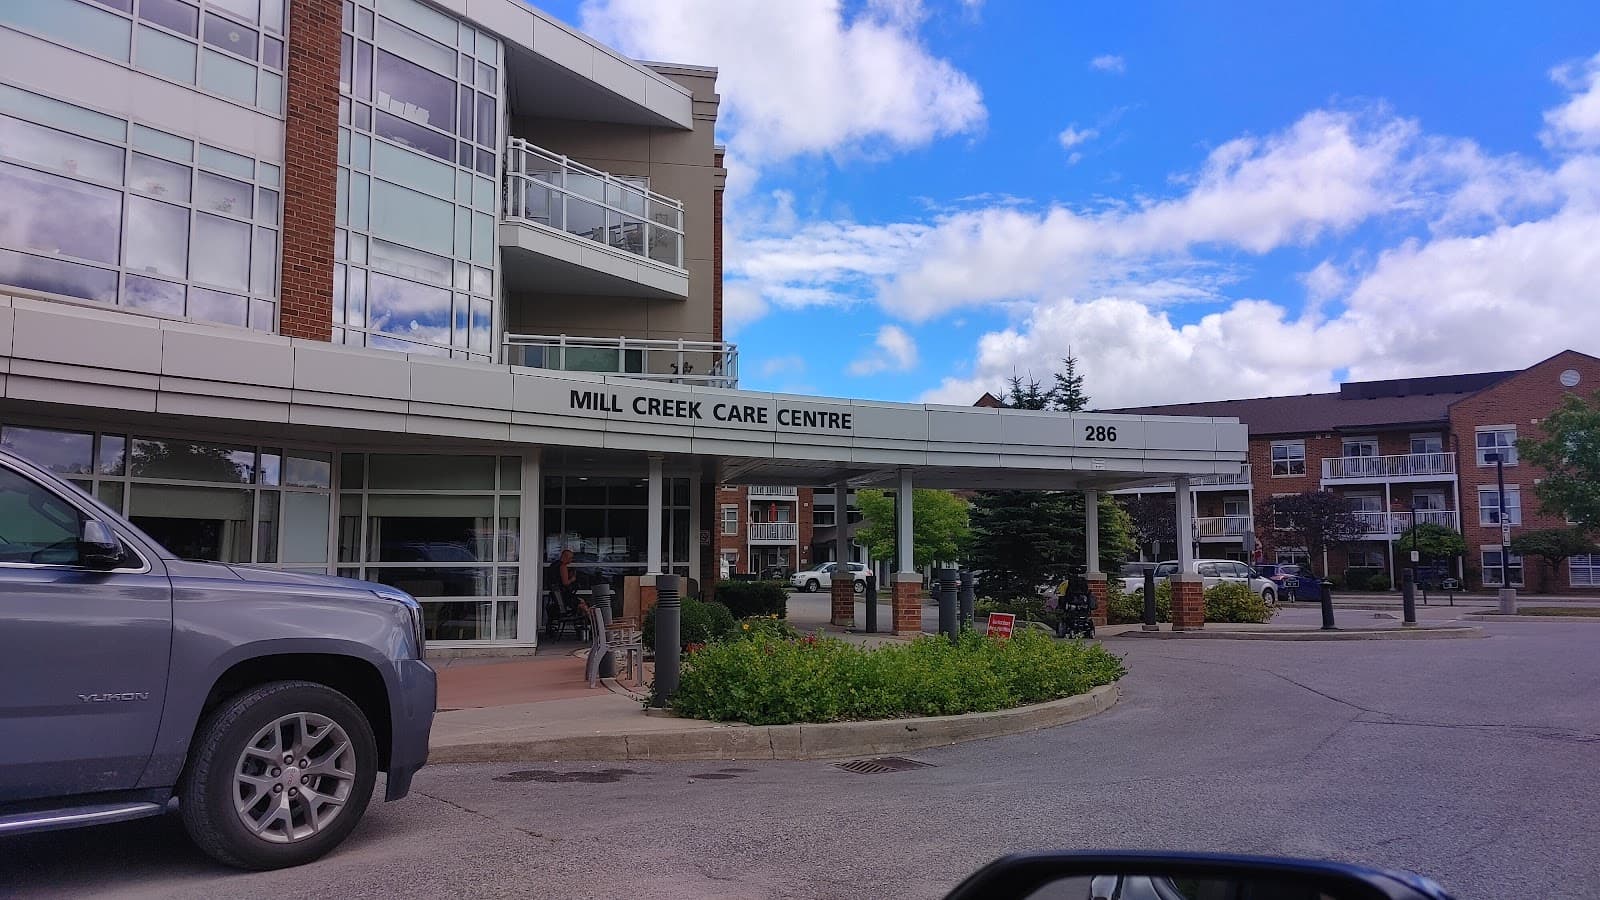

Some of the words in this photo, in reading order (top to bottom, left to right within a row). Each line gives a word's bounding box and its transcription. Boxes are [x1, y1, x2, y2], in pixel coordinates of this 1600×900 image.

[570, 390, 623, 413] MILL
[632, 396, 703, 419] CREEK
[713, 403, 768, 424] CARE
[777, 409, 852, 430] CENTRE
[1085, 425, 1117, 442] 286
[78, 692, 150, 702] YUKON
